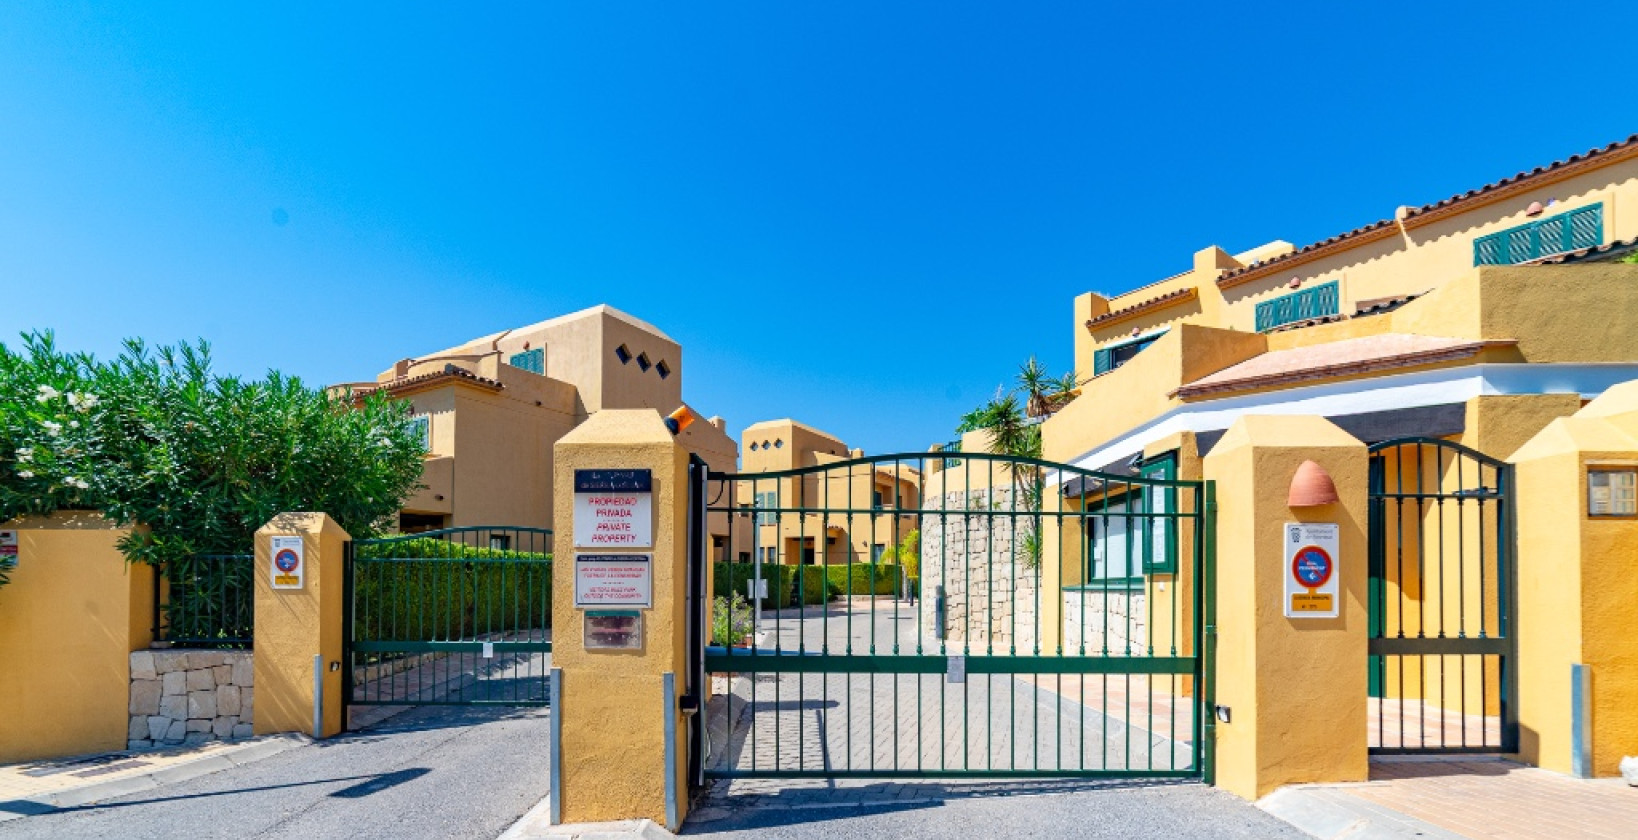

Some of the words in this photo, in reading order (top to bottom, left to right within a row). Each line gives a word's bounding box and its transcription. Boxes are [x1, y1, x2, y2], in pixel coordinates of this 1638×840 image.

[588, 497, 637, 505] PROPIEDAD
[596, 509, 632, 517] PRIVADA
[596, 523, 631, 531] PRIVATE
[591, 534, 637, 542] PROPERTY
